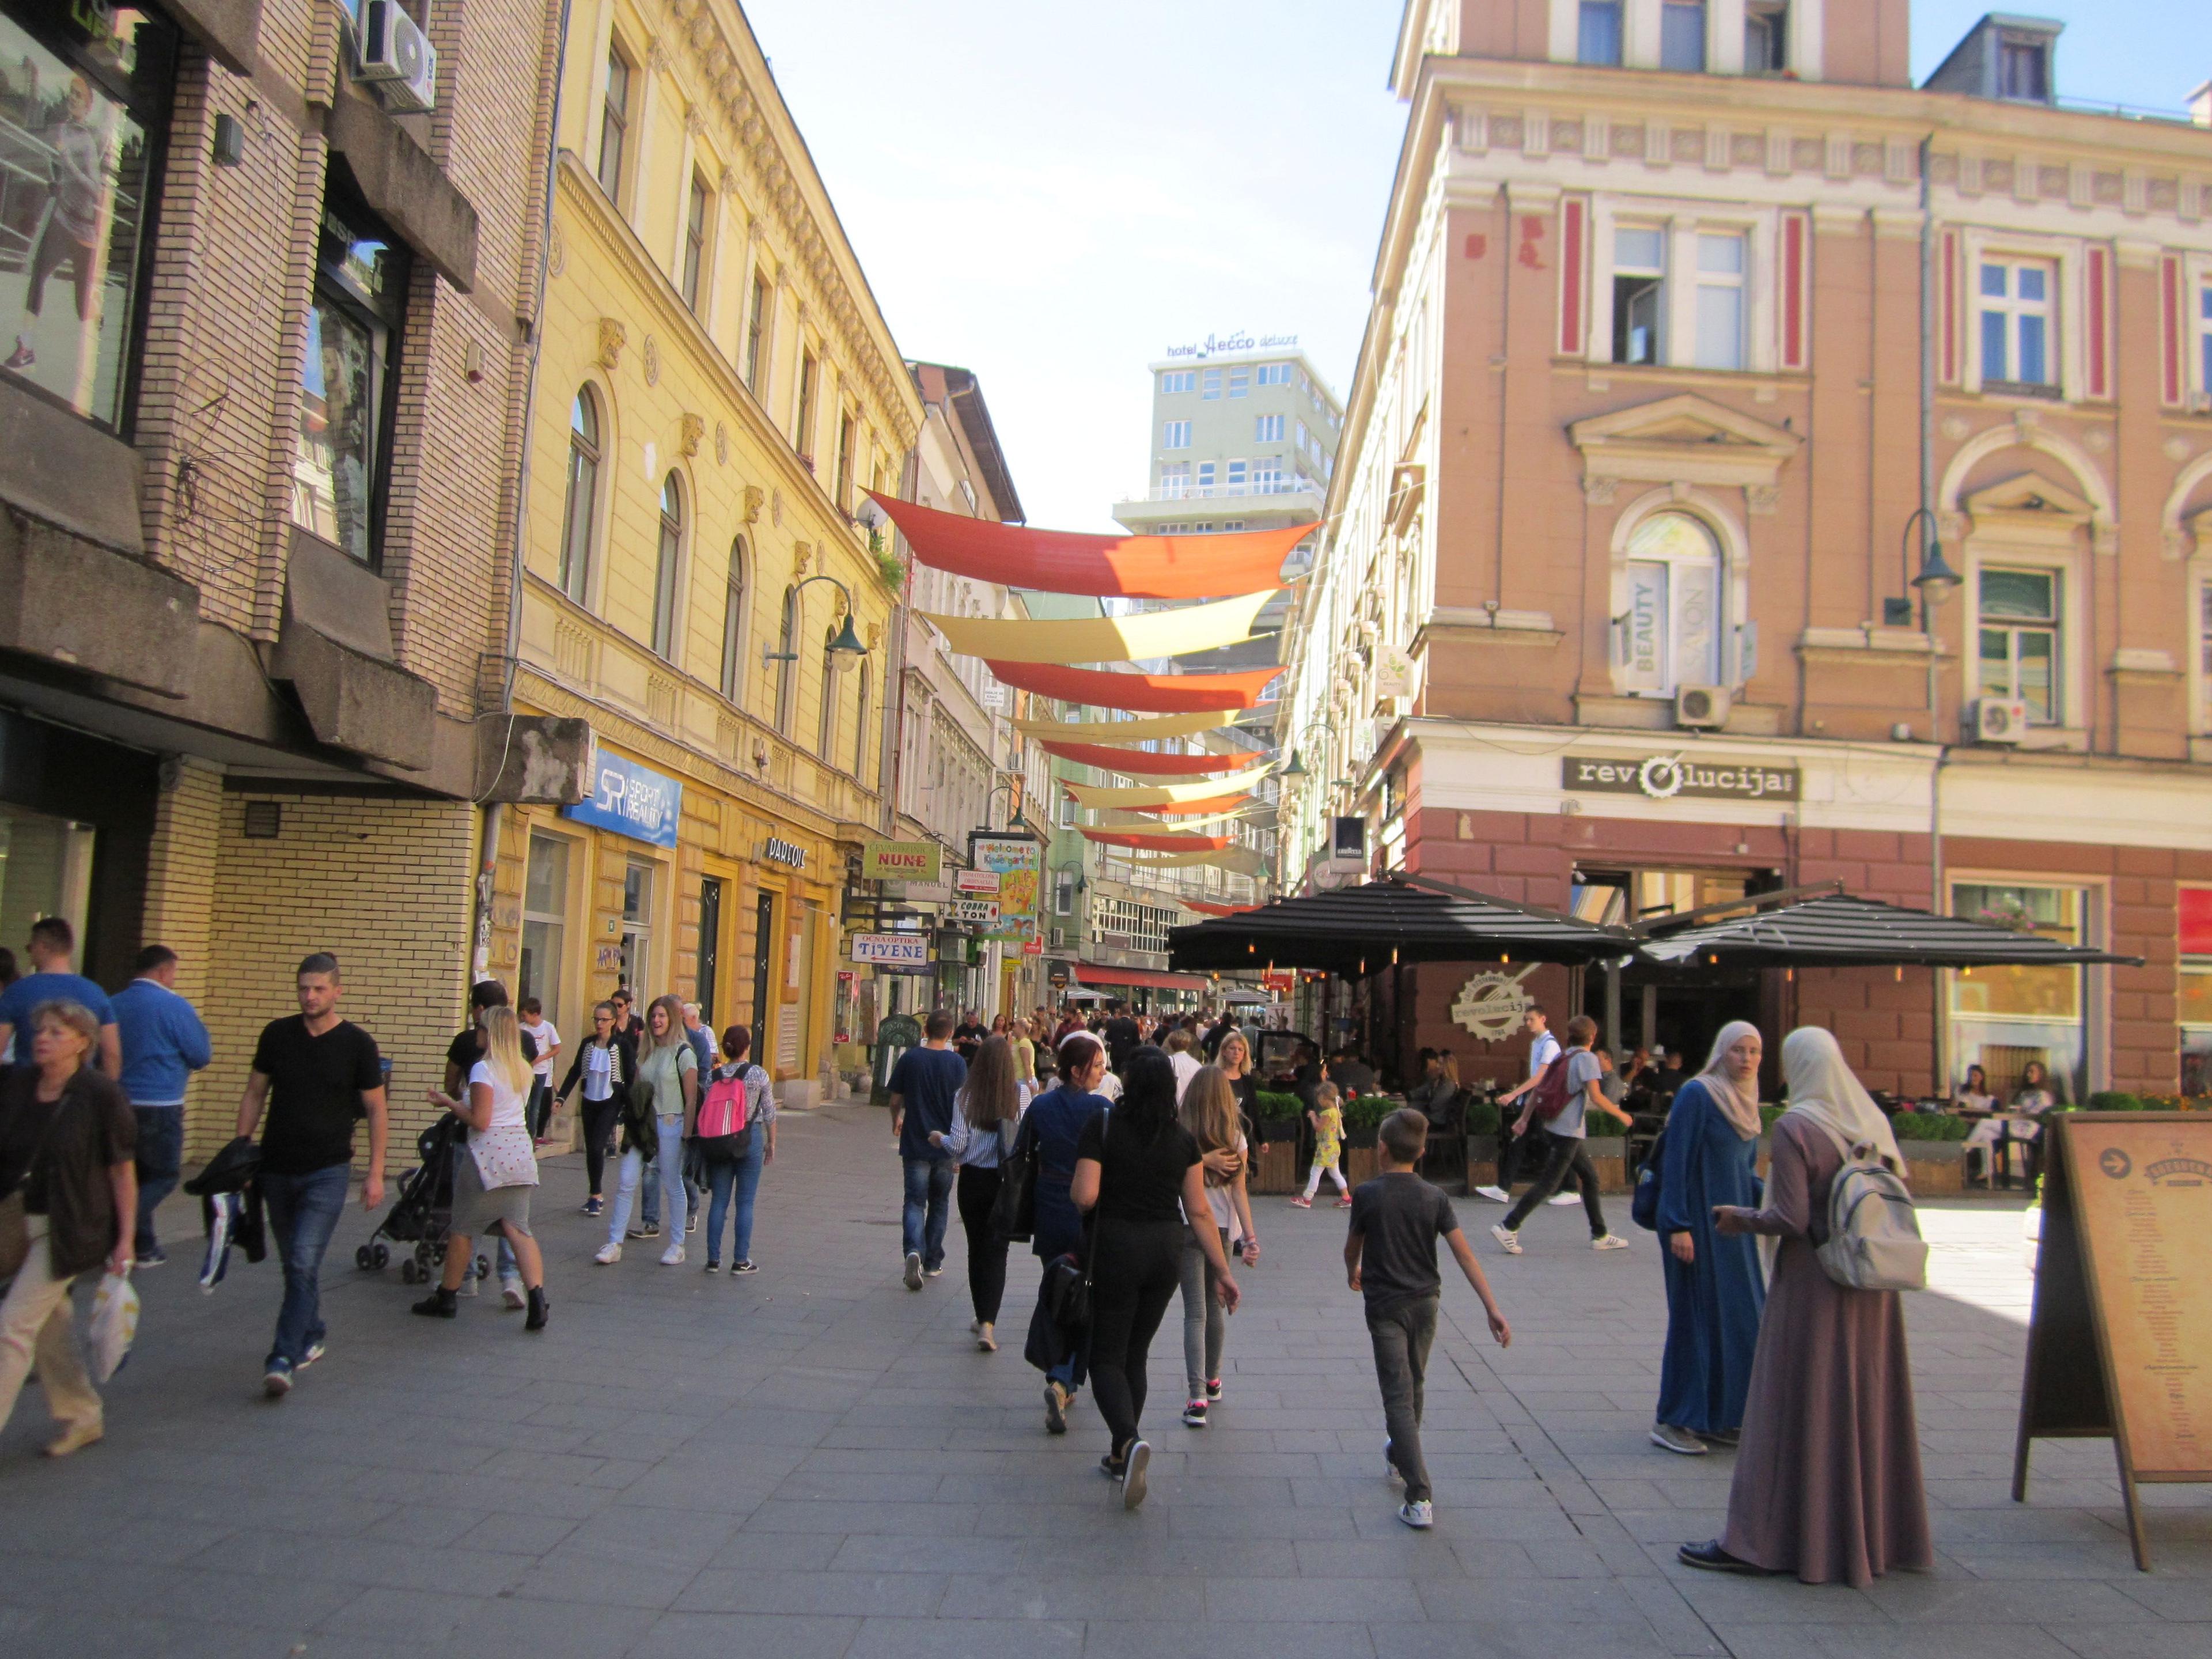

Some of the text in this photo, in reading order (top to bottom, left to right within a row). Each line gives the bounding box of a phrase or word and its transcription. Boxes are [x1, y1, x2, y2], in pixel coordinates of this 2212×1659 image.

[1167, 344, 1197, 357] hotel
[1260, 334, 1298, 346] deluxe
[1636, 582, 1654, 672] BEAUTY
[628, 779, 661, 806] SPORT
[626, 799, 663, 829] REALITY
[769, 838, 808, 869] PARFOIS
[986, 843, 1036, 854] Welcome to
[878, 853, 926, 867] NUNE
[961, 902, 988, 911] COBRA
[963, 911, 986, 919] TON
[1454, 1001, 1531, 1018] revolucij
